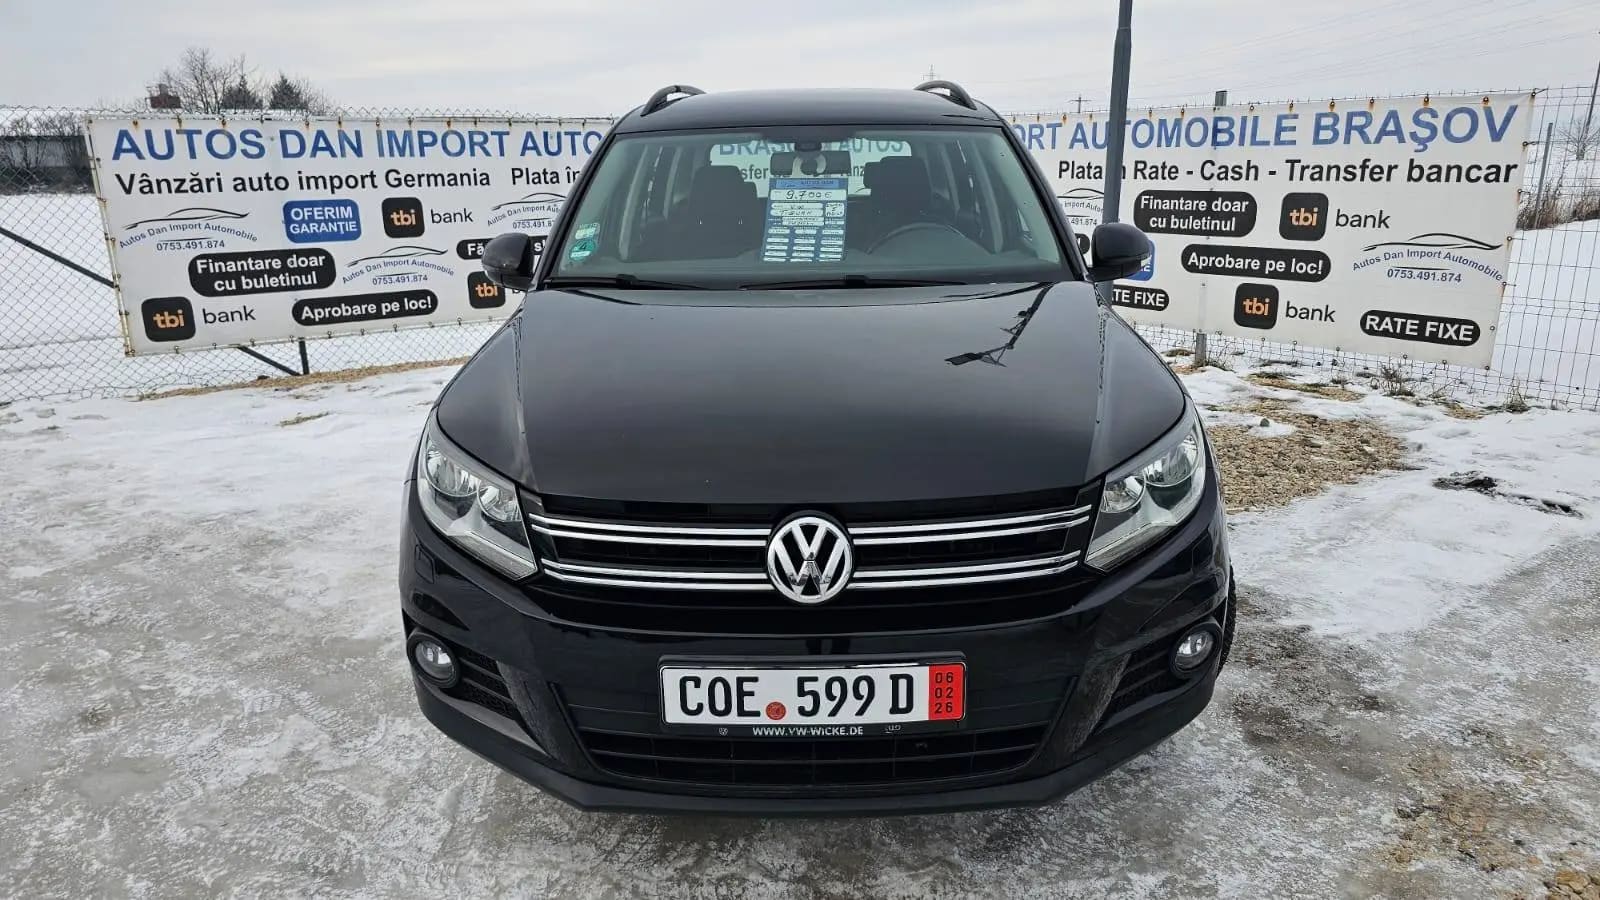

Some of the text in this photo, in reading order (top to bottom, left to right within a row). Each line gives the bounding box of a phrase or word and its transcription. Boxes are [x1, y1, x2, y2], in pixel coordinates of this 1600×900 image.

[112, 129, 604, 160] AUTOS DAN IMPORT AUTO
[1013, 121, 1062, 150] ORT
[511, 168, 560, 186] Plata
[1058, 160, 1103, 180] Plata
[1133, 160, 1180, 181] Rate
[1200, 160, 1259, 181] Cash
[1285, 158, 1398, 183] Transfer
[1406, 158, 1518, 184] bancar
[115, 168, 491, 195] Vânzări auto import Germania
[290, 206, 353, 221] OFERIM
[1140, 195, 1249, 213] Finantare doar
[390, 208, 474, 226] tbi bank
[487, 214, 506, 227] Autos
[507, 208, 521, 217] Dan
[522, 205, 545, 214] Import
[1149, 215, 1236, 232] cu buletinul
[1289, 208, 1391, 229] tbi bank
[120, 222, 258, 249] Autos Dan Import Automobile
[156, 240, 225, 251] 0753.491.874
[196, 253, 326, 274] Finantare doar
[342, 259, 455, 284] Autos Dan Import Automobile
[1188, 252, 1323, 275] Aprobare pe loc!
[1352, 249, 1503, 281] Autos Dan Import Automobile
[214, 271, 318, 292] cu buletinul
[372, 274, 428, 286] 0753.491.874
[1387, 268, 1462, 283] 0753.491.874
[301, 296, 432, 321] Aprobare pe loc!
[1134, 290, 1165, 307] FIXE
[153, 305, 256, 328] tbi bank
[1243, 298, 1335, 322] tbi bank
[1365, 315, 1474, 342] RATE FIXE
[935, 671, 954, 684] 06
[679, 675, 761, 717] COE
[796, 675, 876, 717] 599
[889, 673, 914, 715] D
[935, 686, 954, 699] 02
[934, 701, 953, 714] 26
